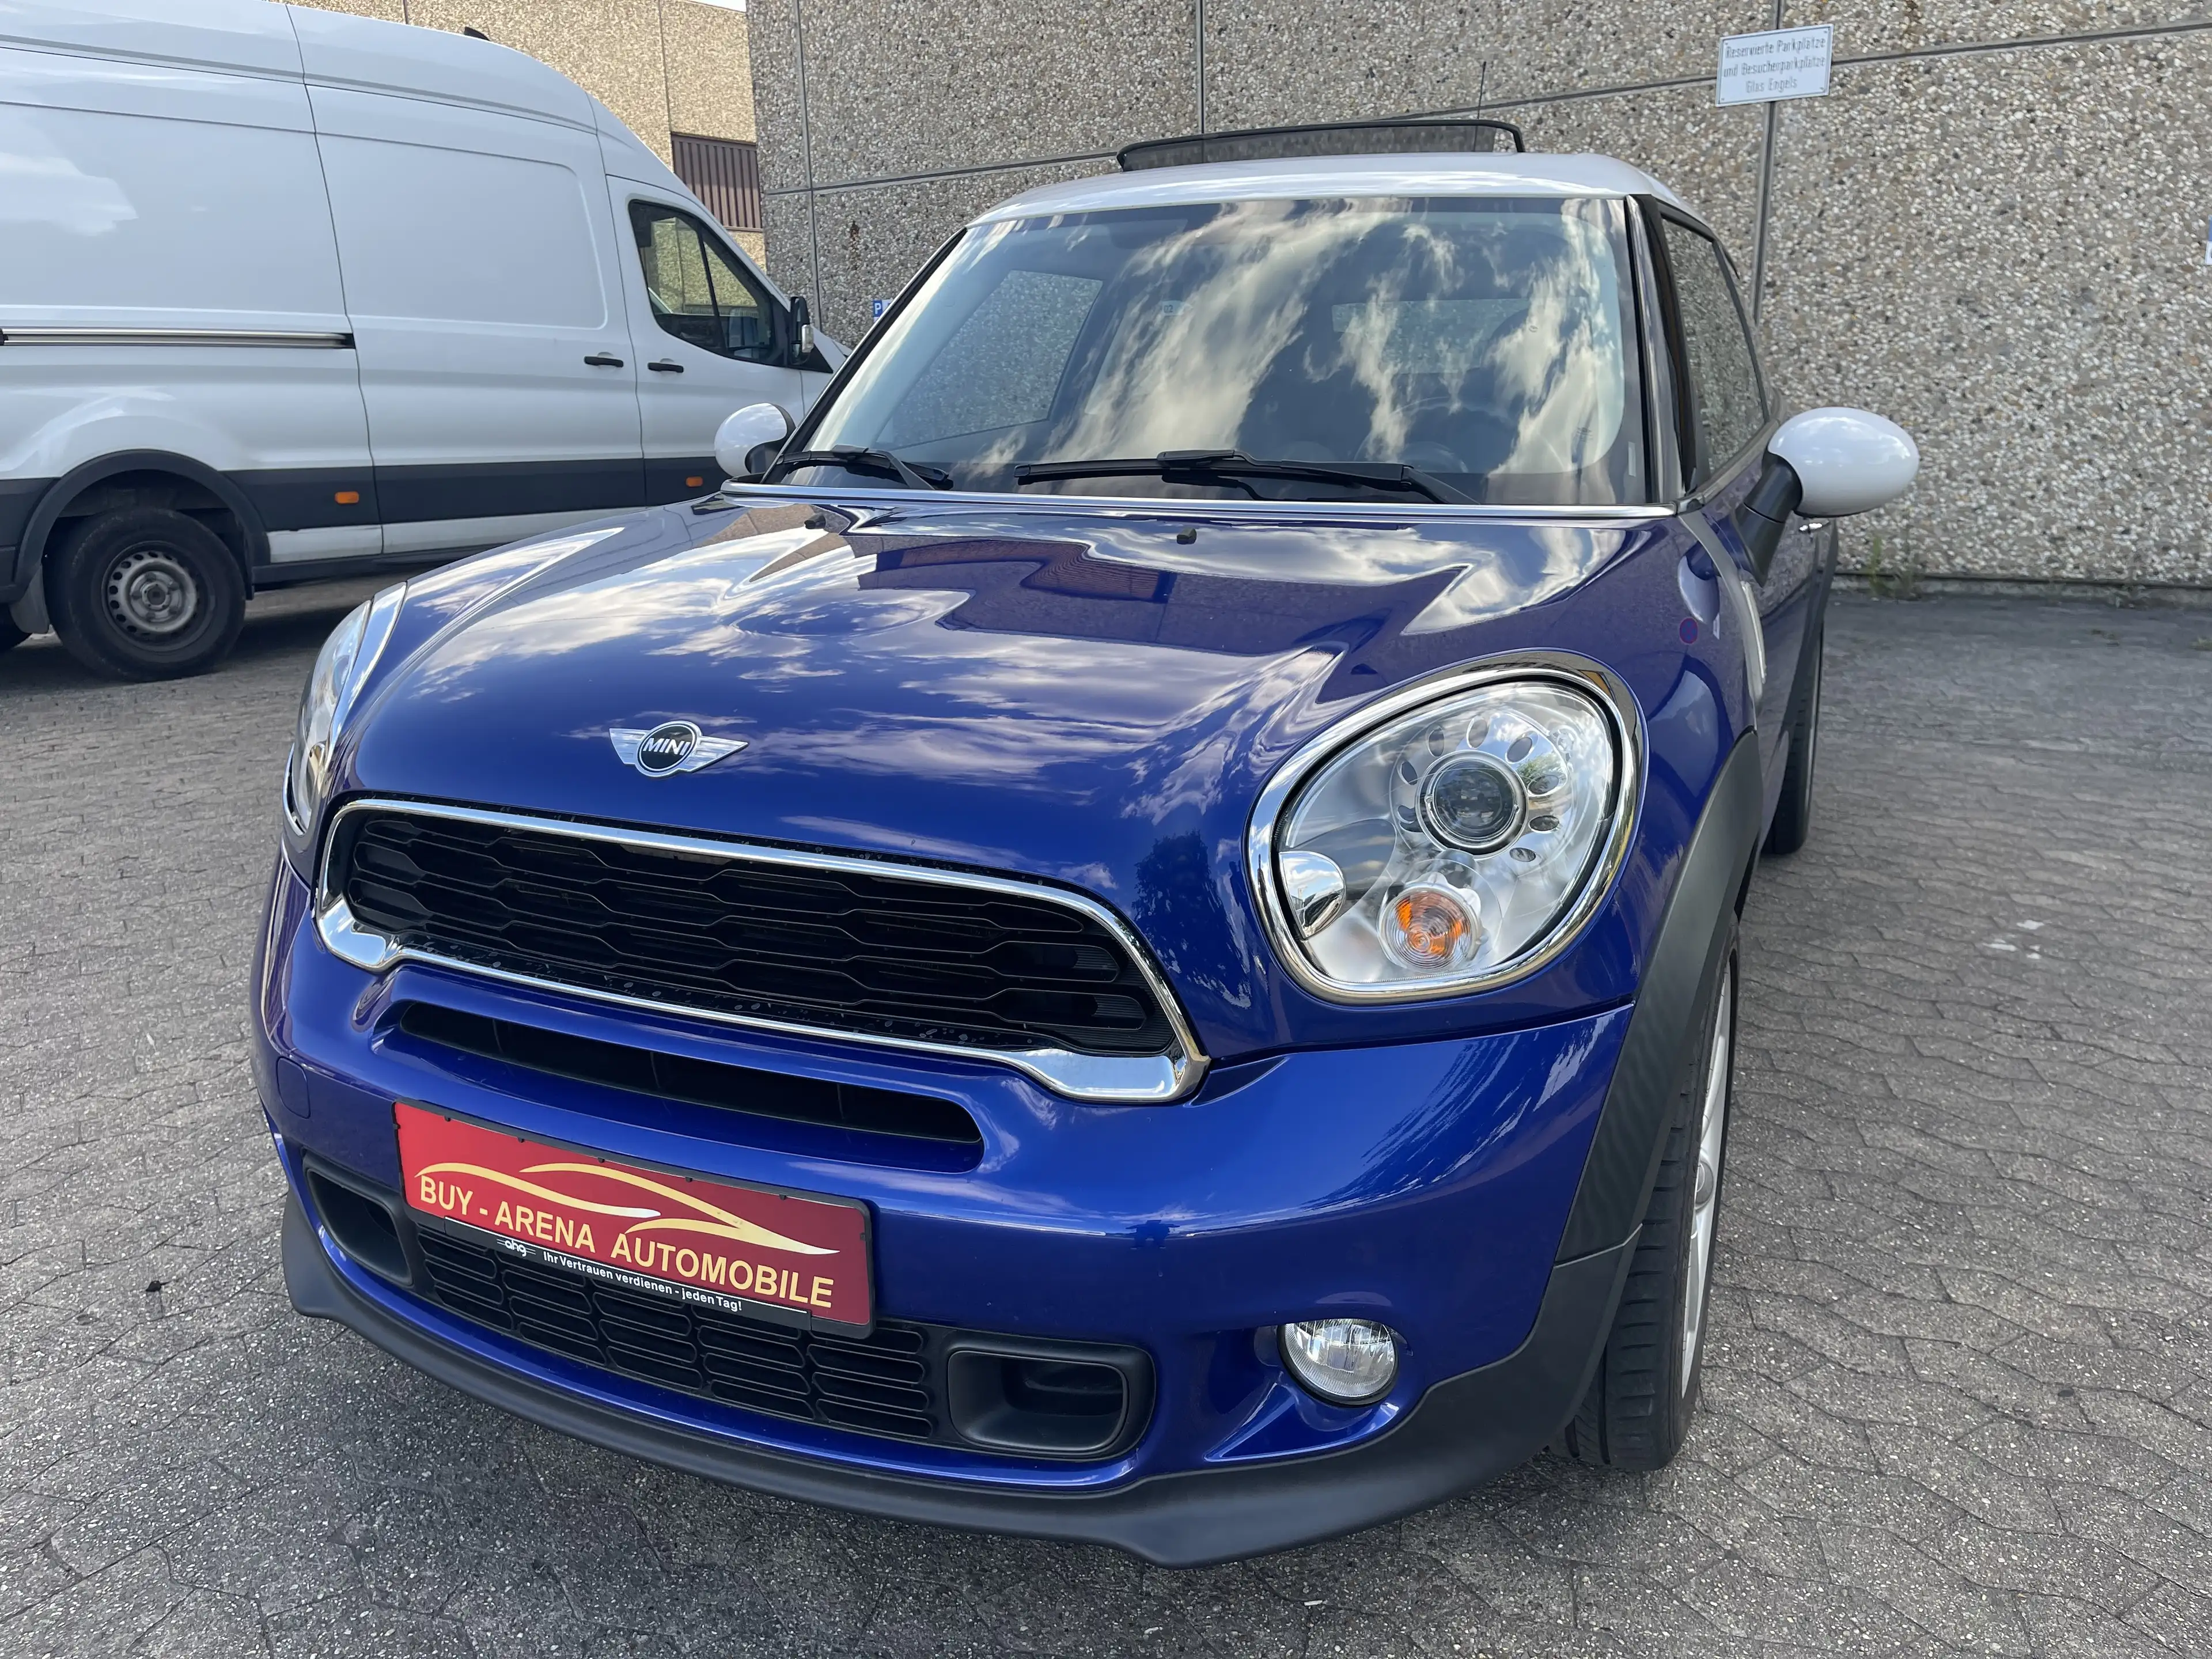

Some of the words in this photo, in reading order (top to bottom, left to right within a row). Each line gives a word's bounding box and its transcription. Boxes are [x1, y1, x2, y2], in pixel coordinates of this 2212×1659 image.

[1724, 64, 1738, 77] und
[1768, 75, 1797, 93] Engels
[874, 302, 881, 315] P
[643, 737, 691, 756] MINI
[421, 1175, 473, 1215] BUY
[494, 1200, 596, 1253] ARENA
[610, 1233, 834, 1308] AUTOMOBILE
[543, 1251, 558, 1264] Ihr
[559, 1255, 613, 1279] Vertrauen
[615, 1272, 672, 1294] verdienen
[682, 1287, 715, 1305] jeden
[716, 1296, 742, 1312] Tag!
